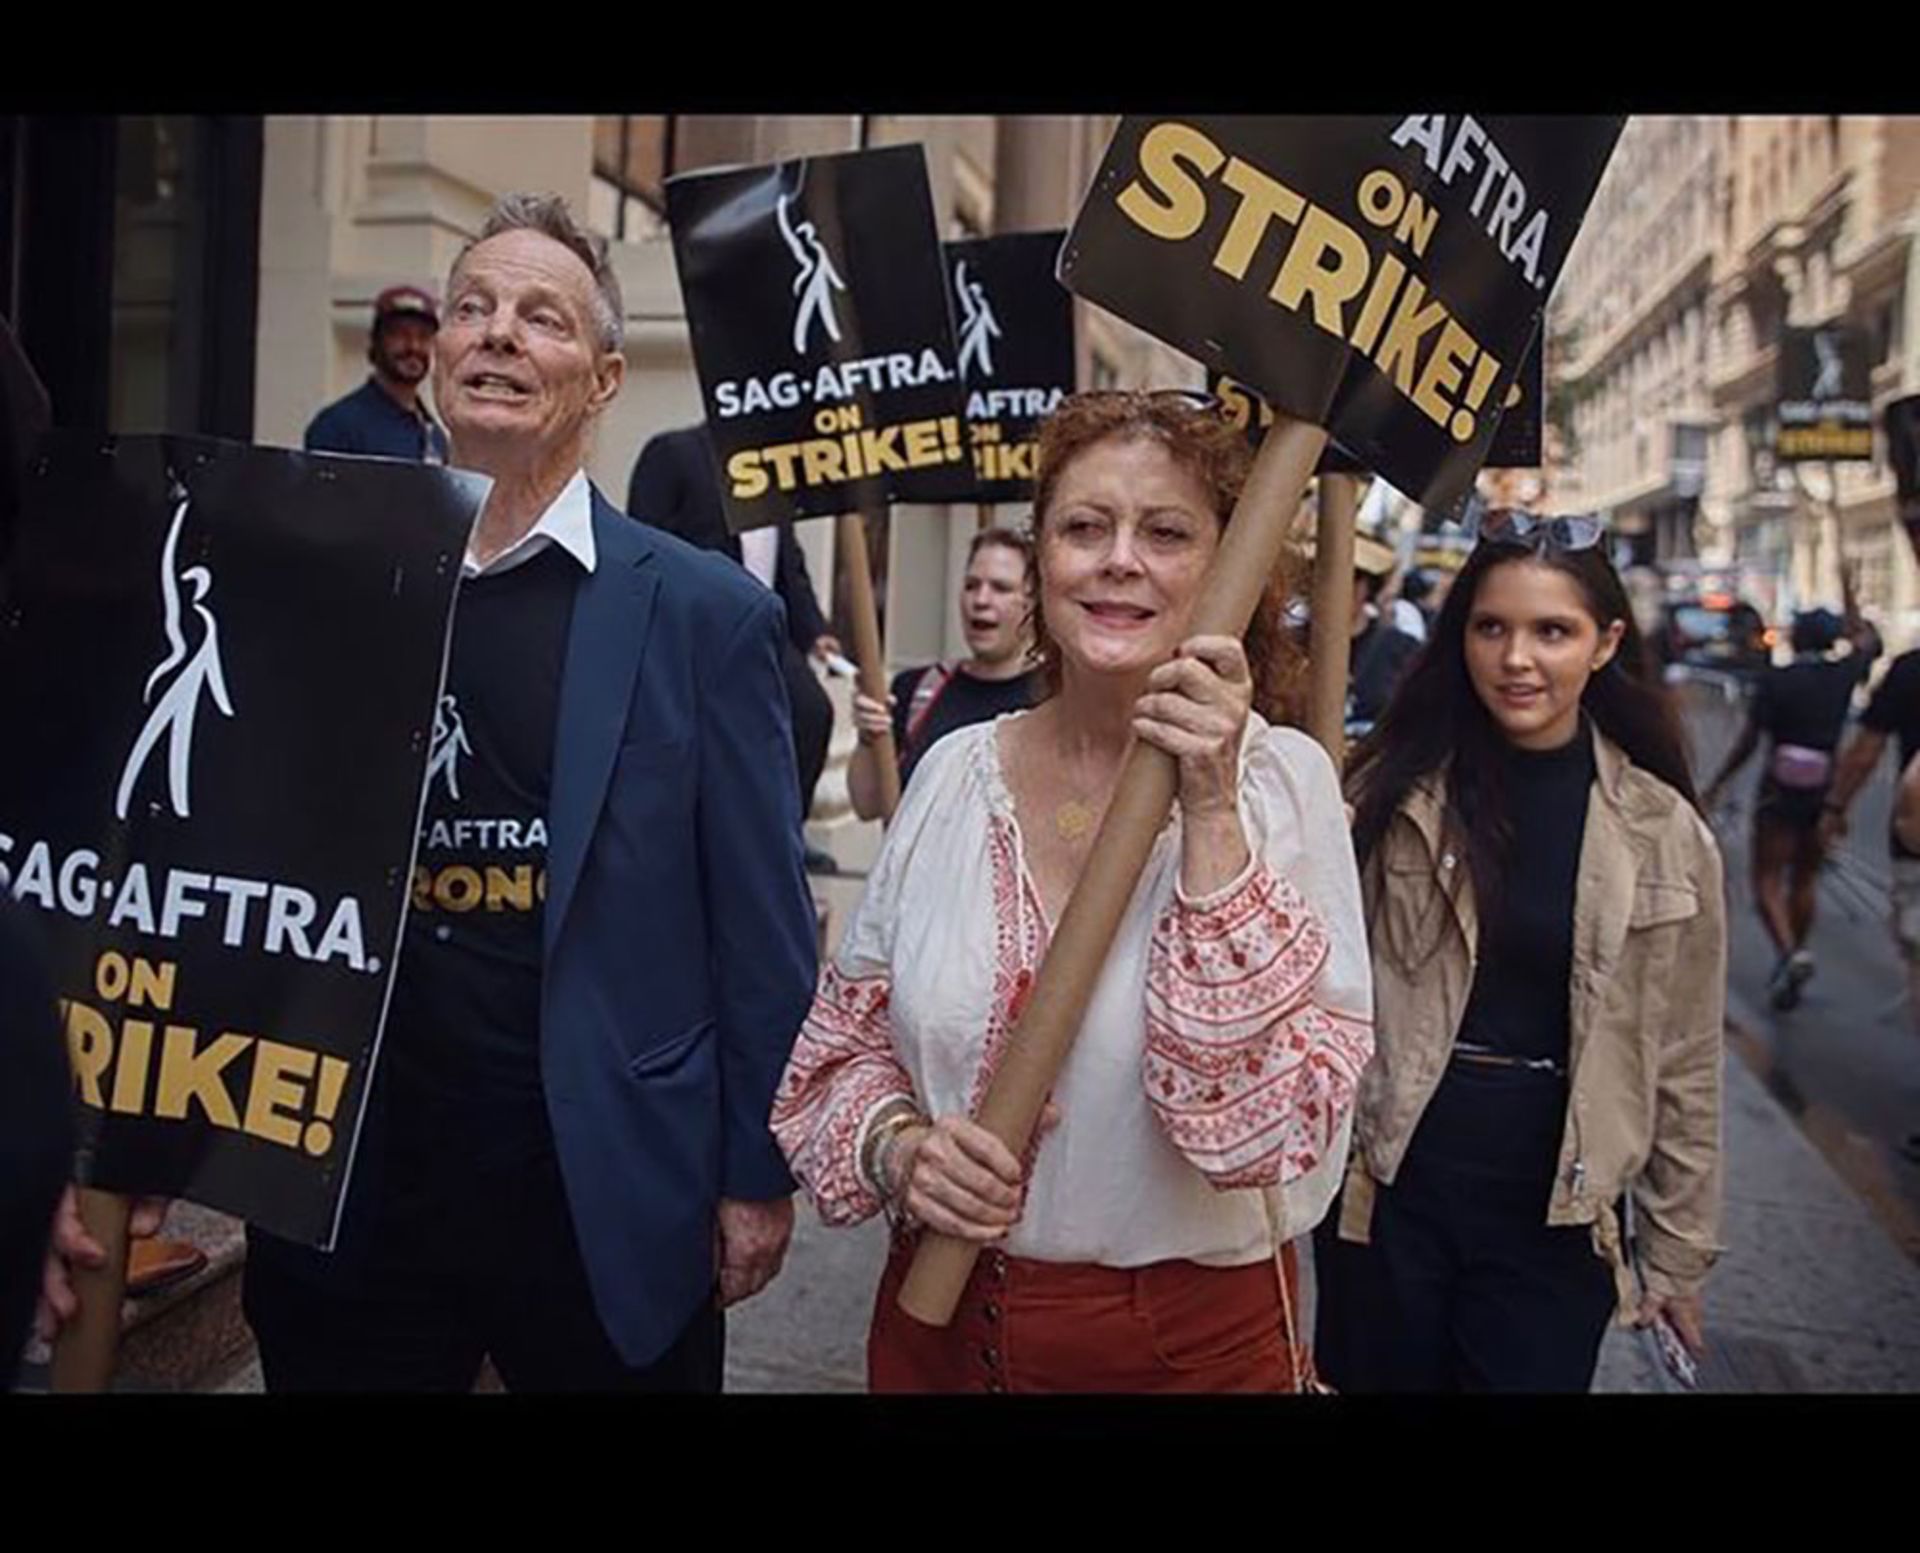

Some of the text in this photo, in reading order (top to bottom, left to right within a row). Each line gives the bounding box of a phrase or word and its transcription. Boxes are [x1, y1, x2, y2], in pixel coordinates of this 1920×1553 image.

[1358, 170, 1439, 257] ON
[1115, 122, 1501, 442] STRIKE!
[727, 416, 963, 499] STRIKE!
[814, 404, 862, 434] ON
[96, 951, 177, 1010] ON
[60, 997, 350, 1156] RIKE!
